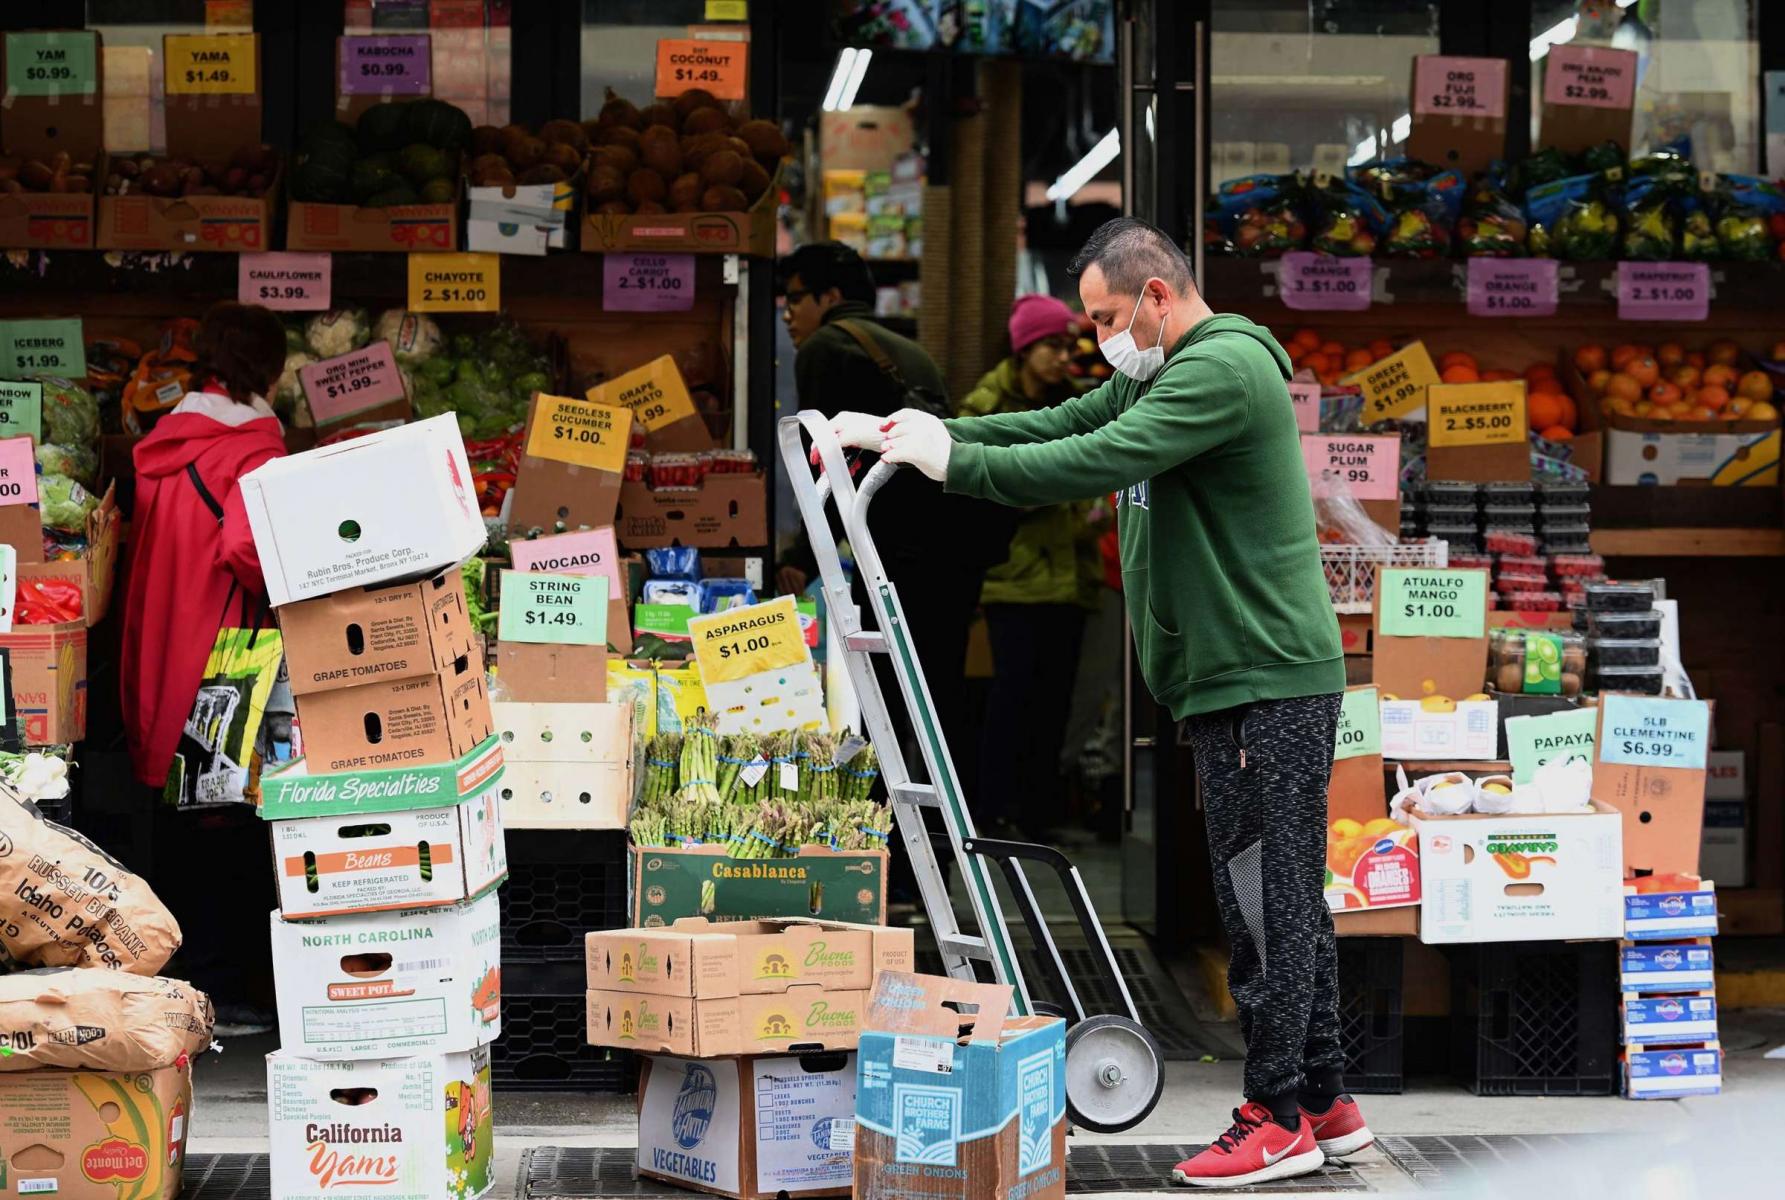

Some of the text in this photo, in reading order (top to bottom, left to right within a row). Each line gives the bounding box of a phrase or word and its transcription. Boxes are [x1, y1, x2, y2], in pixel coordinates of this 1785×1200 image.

[36, 50, 65, 60] YAM
[191, 51, 230, 62] YAMA
[357, 46, 414, 56] KABOCHA
[669, 54, 730, 66] COCONUT
[27, 67, 70, 80] $0.99
[186, 69, 229, 83] $1.49
[361, 64, 404, 76] $0.99
[675, 69, 718, 81] $1.49
[1447, 72, 1475, 82] ORG
[1446, 83, 1475, 94] FUJI
[1565, 86, 1608, 100] $2.99
[1432, 95, 1475, 107] $2.99
[633, 257, 666, 266] CELLO
[249, 270, 322, 280] CAULIFLOWER
[425, 272, 484, 283] CHAYOTE
[628, 267, 669, 276] CARROT
[1302, 266, 1351, 277] ORANGE
[618, 277, 682, 290] 2 $1.00
[1294, 280, 1356, 292] 3 $1.00
[1486, 282, 1537, 292] ORANGE
[260, 286, 304, 299] $3.99
[423, 289, 486, 302] 2 $1.00
[1633, 288, 1694, 300] 2 $1.00
[1486, 296, 1530, 308] $1.00
[14, 338, 65, 349] ICEBERG
[17, 354, 59, 368] $1.99
[326, 356, 370, 376] ORG MINI
[315, 360, 385, 388] SWEET PEPPER
[1366, 361, 1404, 385] GREEN
[327, 376, 371, 398] $1.99
[1373, 372, 1410, 394] GRAPE
[619, 381, 655, 402] GRAPE
[1374, 383, 1416, 412] $1.99
[558, 404, 611, 419] SEEDLESS
[1440, 402, 1514, 414] BLACKBERRY
[552, 414, 612, 430] CUCUMBER
[1446, 416, 1511, 431] 2 $5.00
[554, 426, 600, 444] $1.00
[1328, 443, 1375, 454] SUGAR
[1330, 456, 1368, 466] PLUM
[1322, 468, 1369, 482] $199
[307, 567, 331, 580] Rubin
[356, 553, 390, 566] Produce
[392, 546, 414, 560] Corp.
[530, 552, 601, 572] AVOCADO
[312, 578, 324, 588] NYC
[326, 572, 354, 584] Terminal
[380, 561, 398, 570] Bronx
[399, 558, 408, 566] NY
[529, 580, 582, 592] STRING
[1402, 578, 1464, 588] ATUALFO
[388, 594, 402, 602] DRY
[536, 594, 574, 605] BEAN
[1408, 589, 1458, 600] MANGO
[525, 610, 576, 625] $1.49
[1405, 604, 1454, 618] $1.00
[706, 612, 785, 639] ASPARAGUS
[719, 635, 769, 660] $1.00
[313, 660, 408, 682] GRAPE TOMATOES
[1534, 732, 1594, 749] PAPAYA
[1614, 728, 1696, 741] CLEMENTINE
[1623, 740, 1672, 756] $6.99
[330, 748, 425, 770] GRAPE TOMATOES
[278, 773, 441, 806] Florida Specialties
[416, 812, 450, 820] PRODUCE
[344, 852, 392, 870] Beans
[712, 862, 808, 880] Casablanca
[332, 874, 409, 889] KEEP REFRIGERATED
[28, 854, 148, 961] RUSSET BURBANK
[14, 878, 122, 971] Idaho Potatoes
[30, 914, 61, 946] GLUTEN
[302, 927, 433, 947] NORTH CAROLINA
[804, 941, 855, 967] Buona
[331, 987, 367, 999] SWEET
[806, 1001, 856, 1028] Buona
[350, 1040, 430, 1052] LARGE COMMERCIAL
[418, 1061, 432, 1069] USA
[904, 1095, 951, 1110] CHURCH
[904, 1107, 950, 1119] BROTHERS
[916, 1118, 950, 1130] FARMS
[306, 1123, 402, 1144] California
[87, 1156, 144, 1170] Del Monte
[306, 1141, 399, 1189] Yams
[653, 1147, 716, 1184] VEGETABLES
[883, 1163, 968, 1180] GREEN ONIONS
